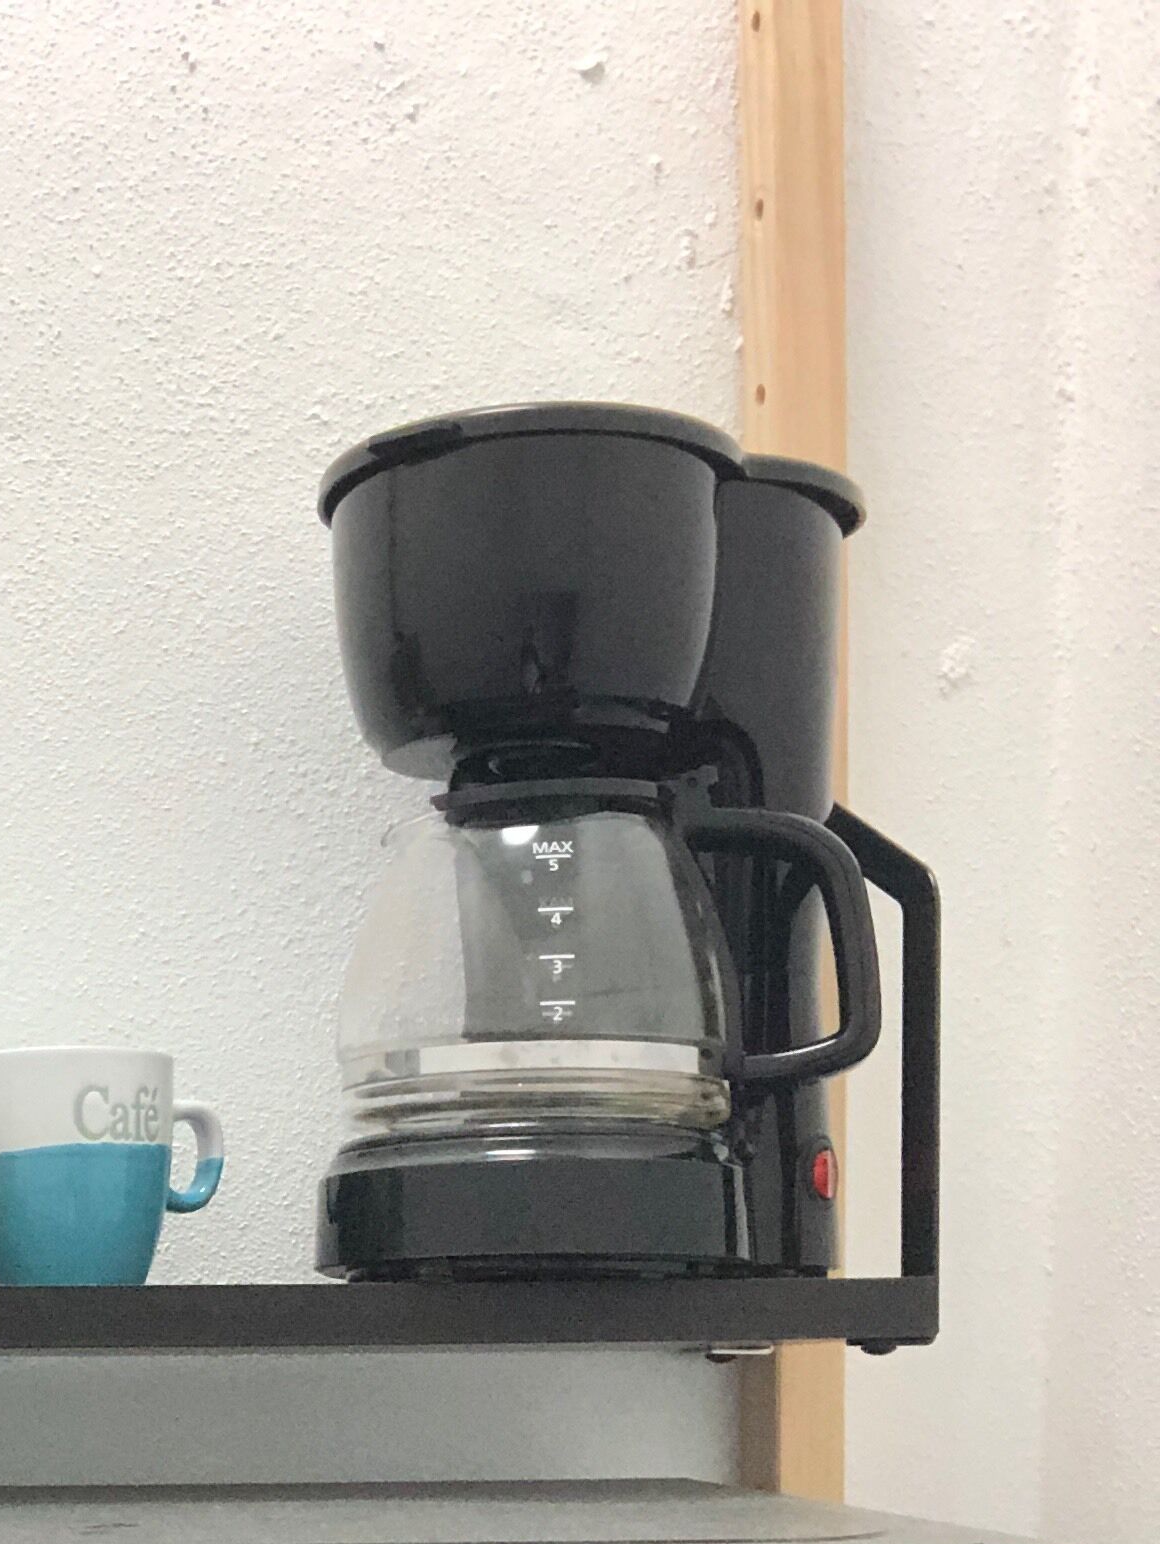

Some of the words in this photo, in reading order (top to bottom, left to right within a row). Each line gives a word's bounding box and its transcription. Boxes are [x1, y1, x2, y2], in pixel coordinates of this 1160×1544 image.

[532, 841, 574, 854] MAX
[549, 859, 559, 872] 5
[551, 912, 562, 925] 4
[553, 960, 562, 974] 3
[553, 1006, 563, 1021] 2
[73, 1084, 160, 1142] Café
